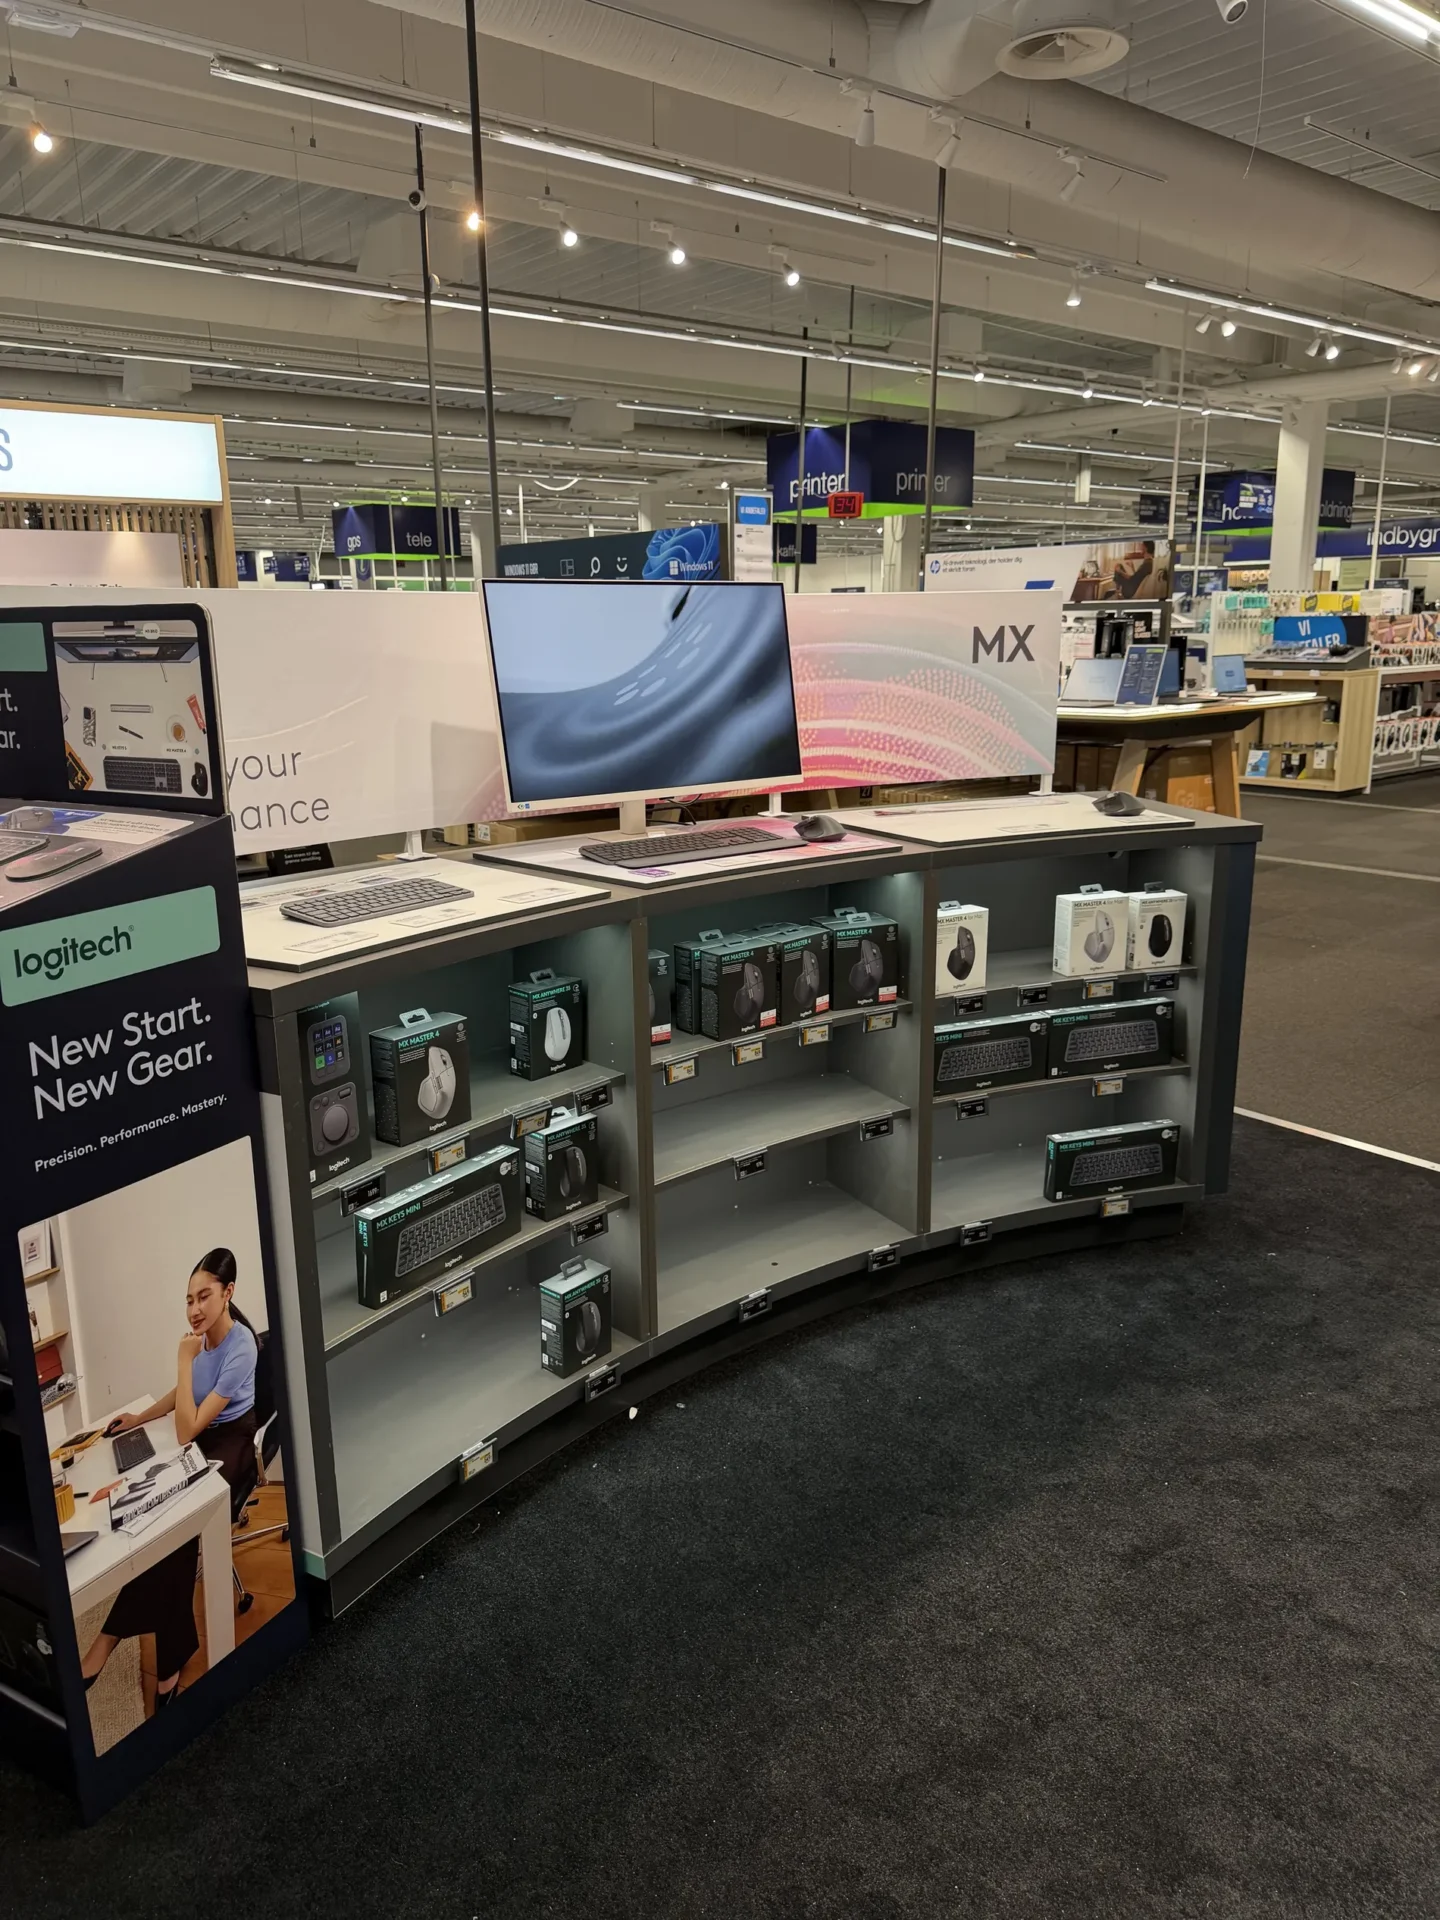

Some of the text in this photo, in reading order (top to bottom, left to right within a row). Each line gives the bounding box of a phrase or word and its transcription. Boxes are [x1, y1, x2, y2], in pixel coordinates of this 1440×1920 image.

[789, 471, 845, 503] printer
[896, 468, 951, 495] priner
[835, 498, 855, 512] 34
[347, 534, 361, 551] gps
[406, 532, 432, 548] tele
[778, 545, 797, 557] kaff
[679, 561, 713, 573] Windows 11
[1298, 619, 1311, 636] VI
[971, 624, 1035, 664] MX
[228, 747, 302, 791] your
[792, 939, 808, 948] MASTER
[730, 952, 750, 960] MASTER
[28, 997, 212, 1077] New Start.
[398, 1030, 440, 1049] MX MASTER 4
[33, 1039, 213, 1120] New Gear.
[34, 1093, 227, 1172] Precision. Performance. Mastery.
[329, 1156, 350, 1172] logitech
[376, 1202, 421, 1230] MX KEYS MINI
[444, 1254, 463, 1268] logitech
